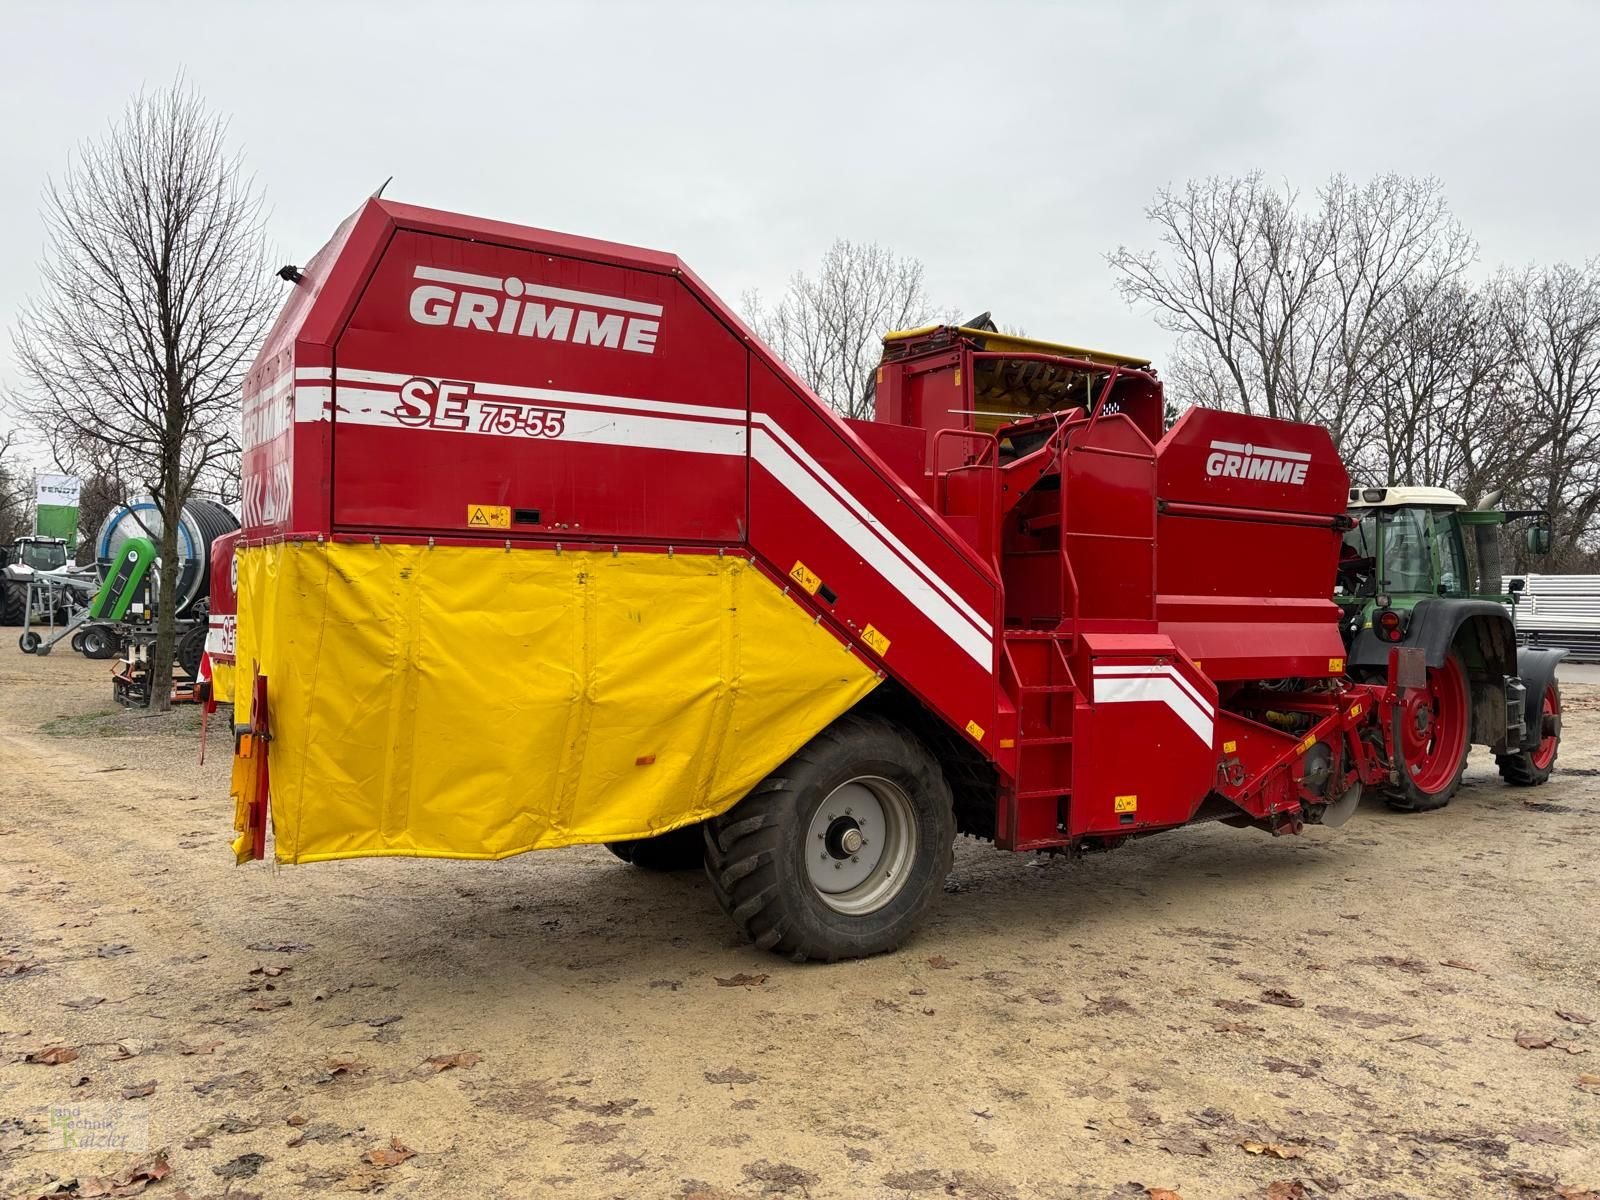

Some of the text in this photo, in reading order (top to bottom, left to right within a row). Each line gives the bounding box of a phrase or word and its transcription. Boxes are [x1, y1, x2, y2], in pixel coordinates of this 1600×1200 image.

[409, 274, 660, 354] GRIMME
[395, 377, 566, 438] SE 75-55
[1206, 442, 1309, 485] GRIMME
[41, 486, 78, 495] FENDT
